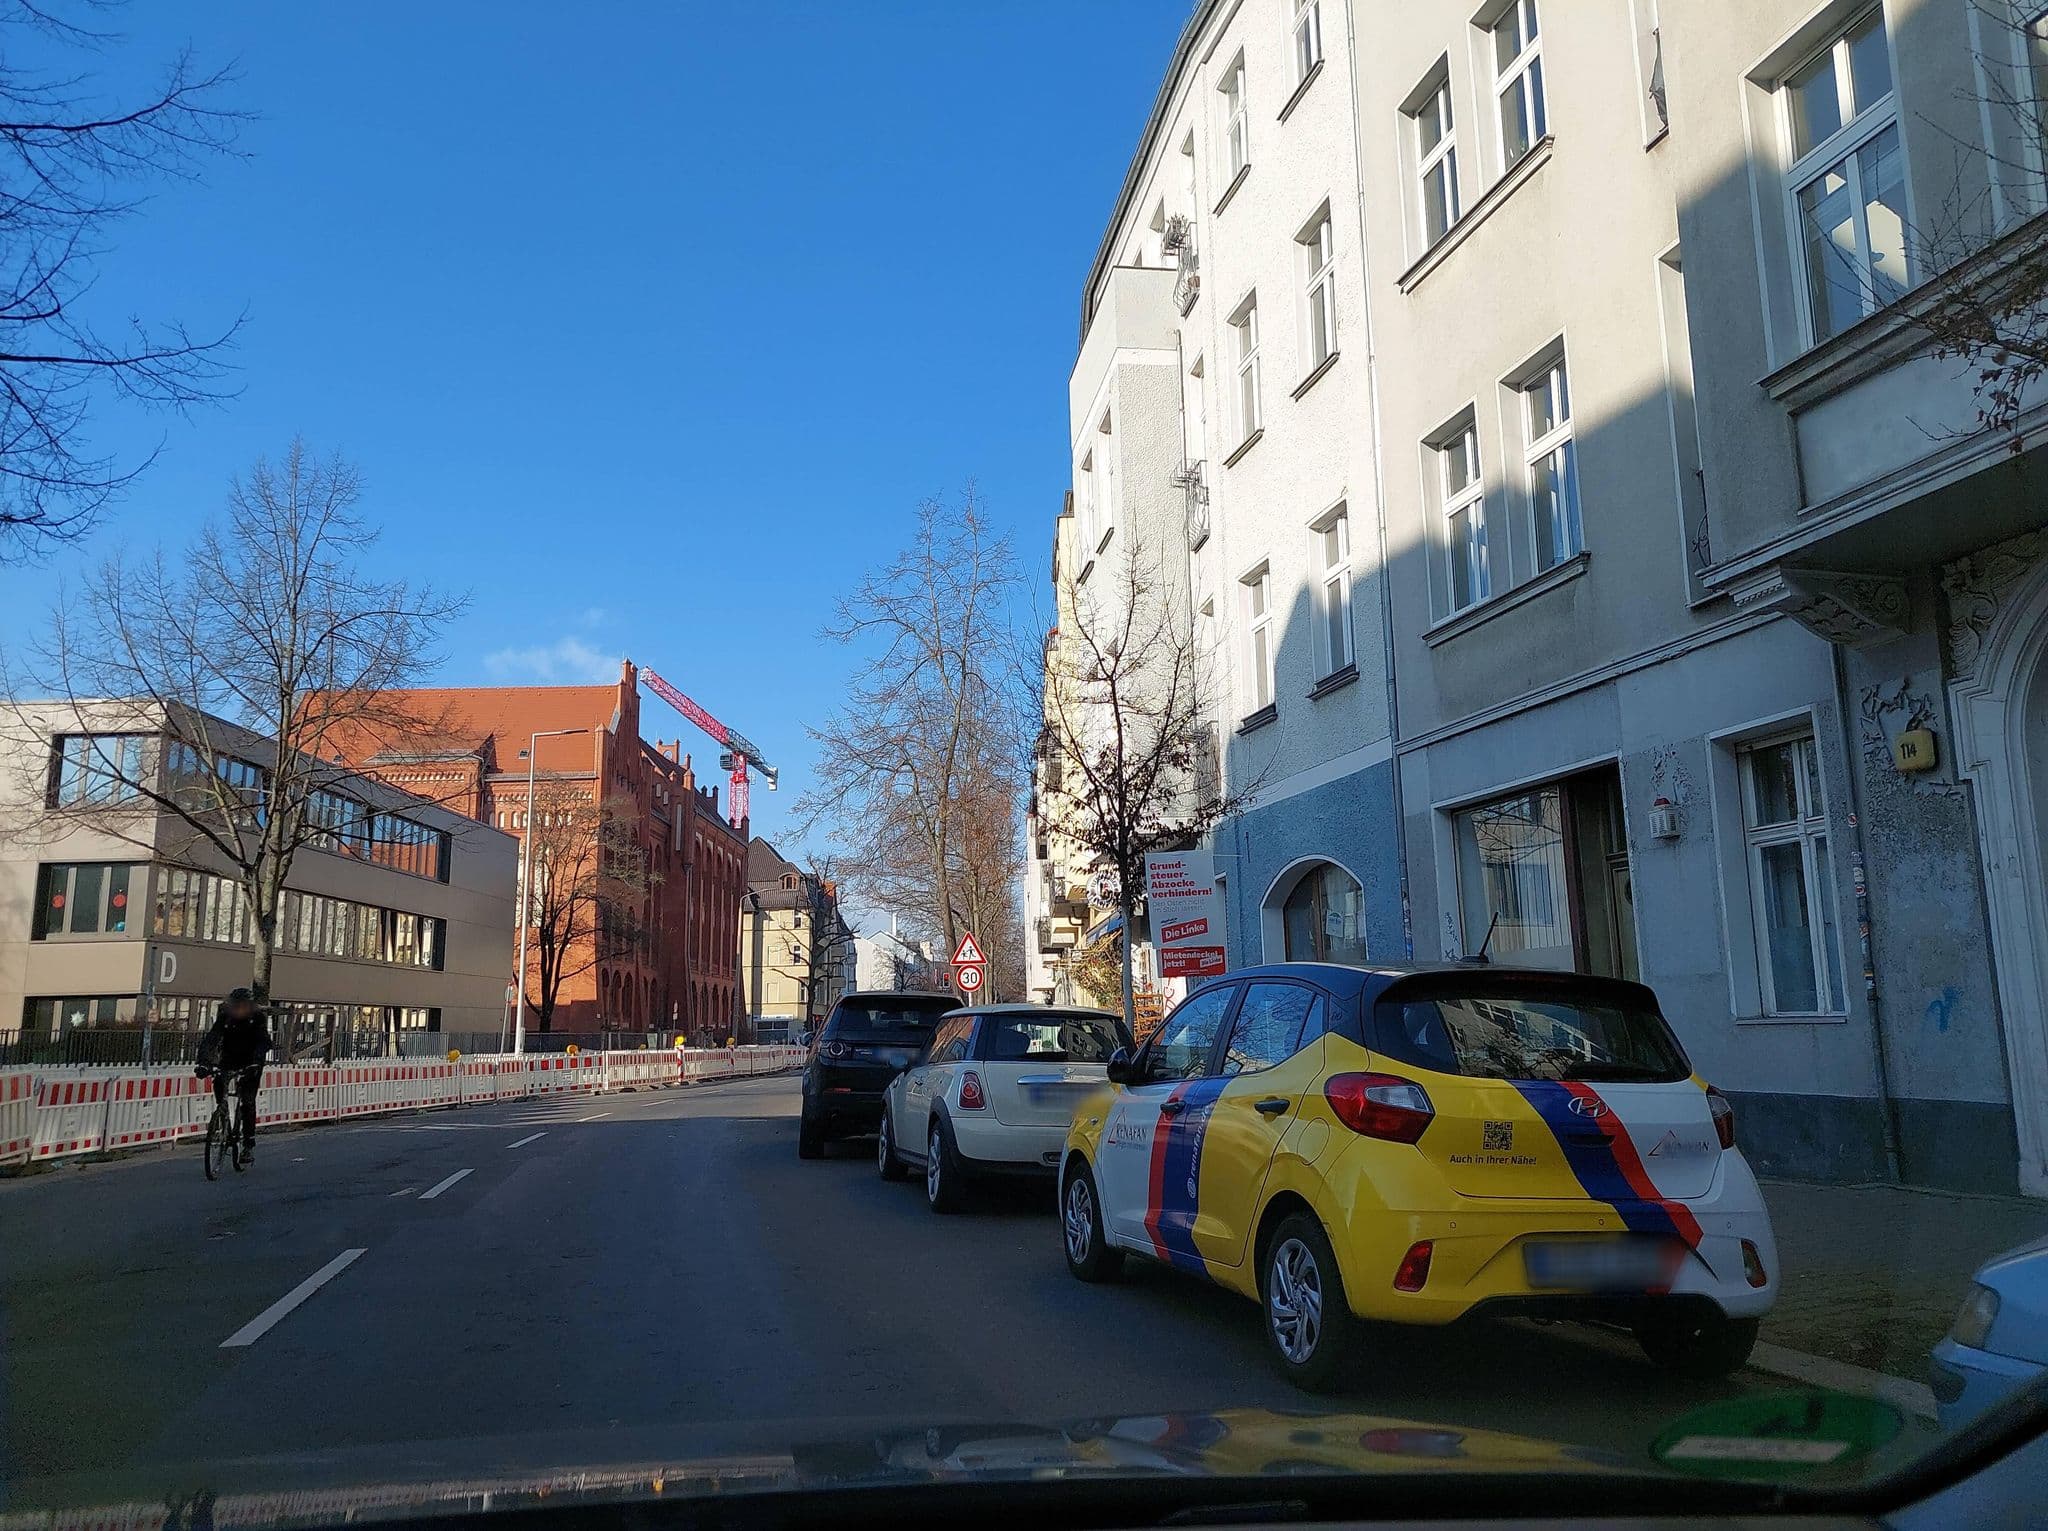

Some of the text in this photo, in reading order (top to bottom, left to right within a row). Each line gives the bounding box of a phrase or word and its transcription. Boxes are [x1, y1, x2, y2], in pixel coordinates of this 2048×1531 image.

[1900, 743, 1917, 759] 114
[1150, 861, 1187, 871] Grund-
[1150, 872, 1189, 880] steuer-
[1151, 880, 1195, 889] Abzocke
[1152, 888, 1212, 899] verhindern!
[1165, 923, 1205, 939] Die Linke
[160, 951, 177, 983] D
[1163, 960, 1186, 970] jetzt!
[962, 971, 978, 984] 30
[1449, 1154, 1537, 1165] Auch in Ihrer Nähe!
